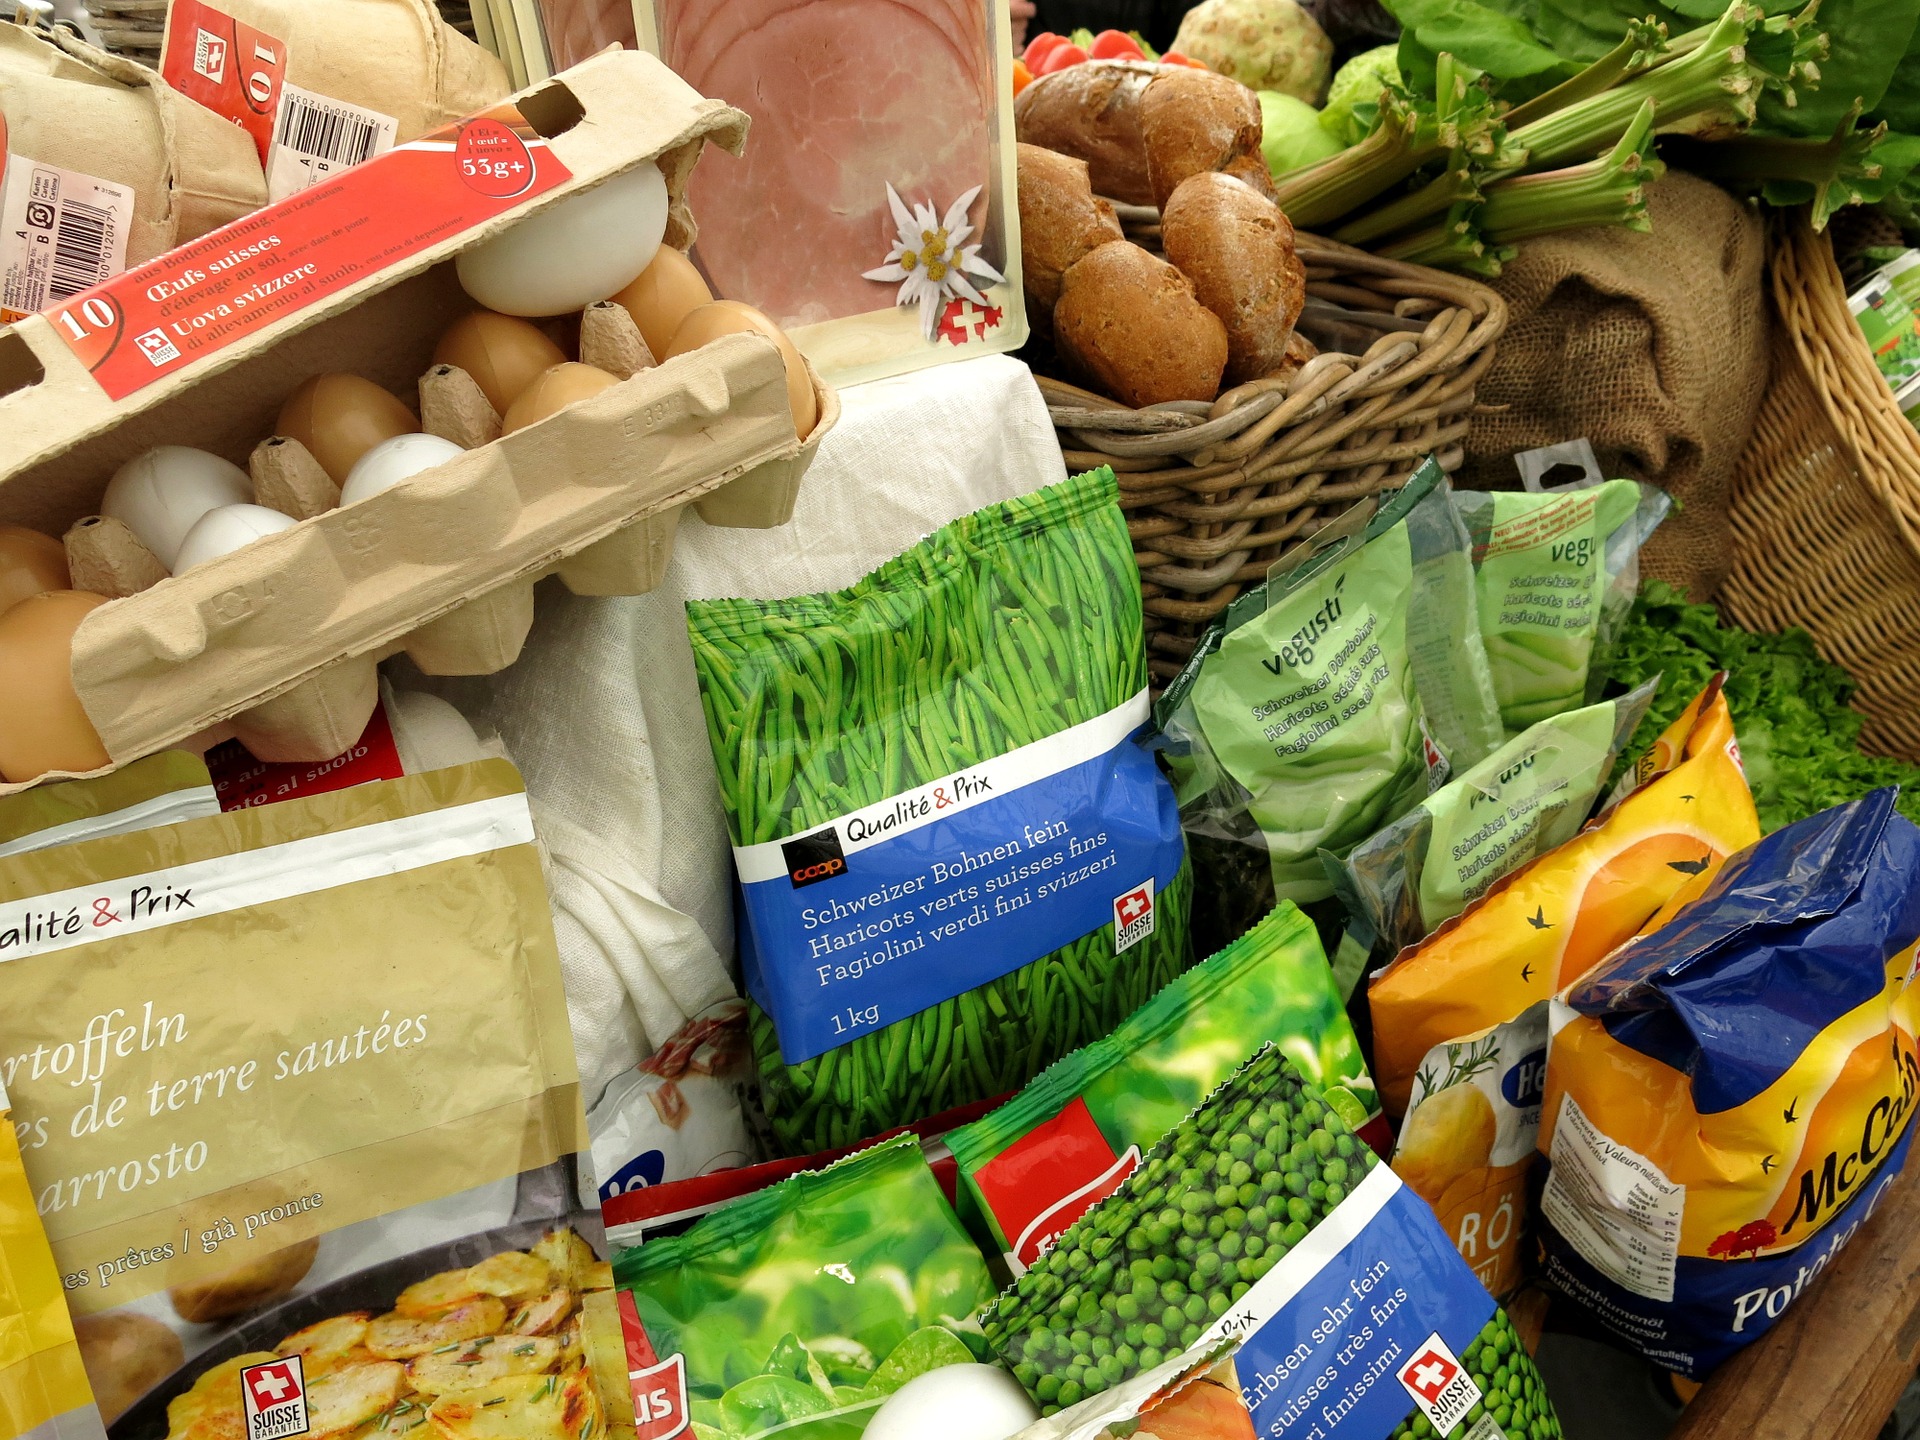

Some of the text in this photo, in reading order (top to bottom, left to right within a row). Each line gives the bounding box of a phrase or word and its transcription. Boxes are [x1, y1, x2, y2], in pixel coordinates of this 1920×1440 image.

[200, 33, 208, 72] SUISSE
[249, 39, 278, 103] 10
[318, 163, 329, 171] B
[462, 158, 525, 179] 53g+
[15, 230, 28, 240] A
[36, 234, 49, 244] B
[133, 267, 160, 284] aus
[162, 213, 275, 270] Bodenhaltung,
[146, 233, 281, 303] Œufs suisses
[160, 275, 233, 318] d'élevage
[235, 268, 256, 283] au
[257, 252, 287, 271] sol,
[310, 231, 330, 248] date
[330, 227, 344, 238] de
[59, 298, 116, 341] 10
[171, 261, 318, 337] Uova svizzere
[186, 335, 204, 351] di
[207, 290, 299, 348] allevamento
[300, 281, 317, 296] al
[319, 262, 364, 288] suolo,
[151, 346, 174, 361] SUISSE
[1499, 610, 1560, 628] Fagiolini
[1503, 593, 1562, 608] Haricots
[1262, 590, 1344, 677] vegusti
[1251, 671, 1331, 722] Schweizer
[1263, 643, 1381, 743] Haricots séchés suis
[1275, 715, 1340, 758] Fagiolini
[307, 746, 368, 782] suolo
[847, 774, 994, 843] Qualité & Prix
[1452, 815, 1507, 861] Schweizer
[1458, 844, 1507, 883] Haricots
[793, 858, 842, 881] coop
[801, 817, 1069, 931] Schweizer Bohnen fein
[808, 831, 1108, 959] Haricots verts suisses fins
[92, 897, 123, 927] &
[130, 886, 195, 920] Prix
[815, 849, 1119, 987] Fagiolini verdi fini svizzeri
[1118, 913, 1151, 942] SUISSE
[1118, 925, 1152, 949] GARANTIE
[70, 1080, 127, 1139] de
[146, 1059, 258, 1117] terre
[274, 1009, 429, 1081] sautées
[37, 1139, 209, 1216] arrosto
[1604, 1144, 1642, 1171] Valeurs
[1640, 1167, 1670, 1195] nutritives
[60, 1269, 90, 1290] es
[97, 1241, 175, 1288] prêtes
[199, 1215, 238, 1254] già
[243, 1190, 324, 1233] pronte
[1458, 1193, 1516, 1257] RÖ
[1546, 1268, 1577, 1297] huile
[1597, 1306, 1668, 1341] tournesol
[1549, 1255, 1664, 1328] Sonnenblumenöl
[1241, 1259, 1391, 1413] Erbsen sehr fein
[1270, 1286, 1408, 1438] suisses très fins
[1322, 1337, 1403, 1429] finissimi
[253, 1404, 301, 1430] SUISSE
[1430, 1375, 1471, 1422] SUISSE
[1439, 1388, 1476, 1430] GARANTIE
[255, 1421, 302, 1439] GARANTIE
